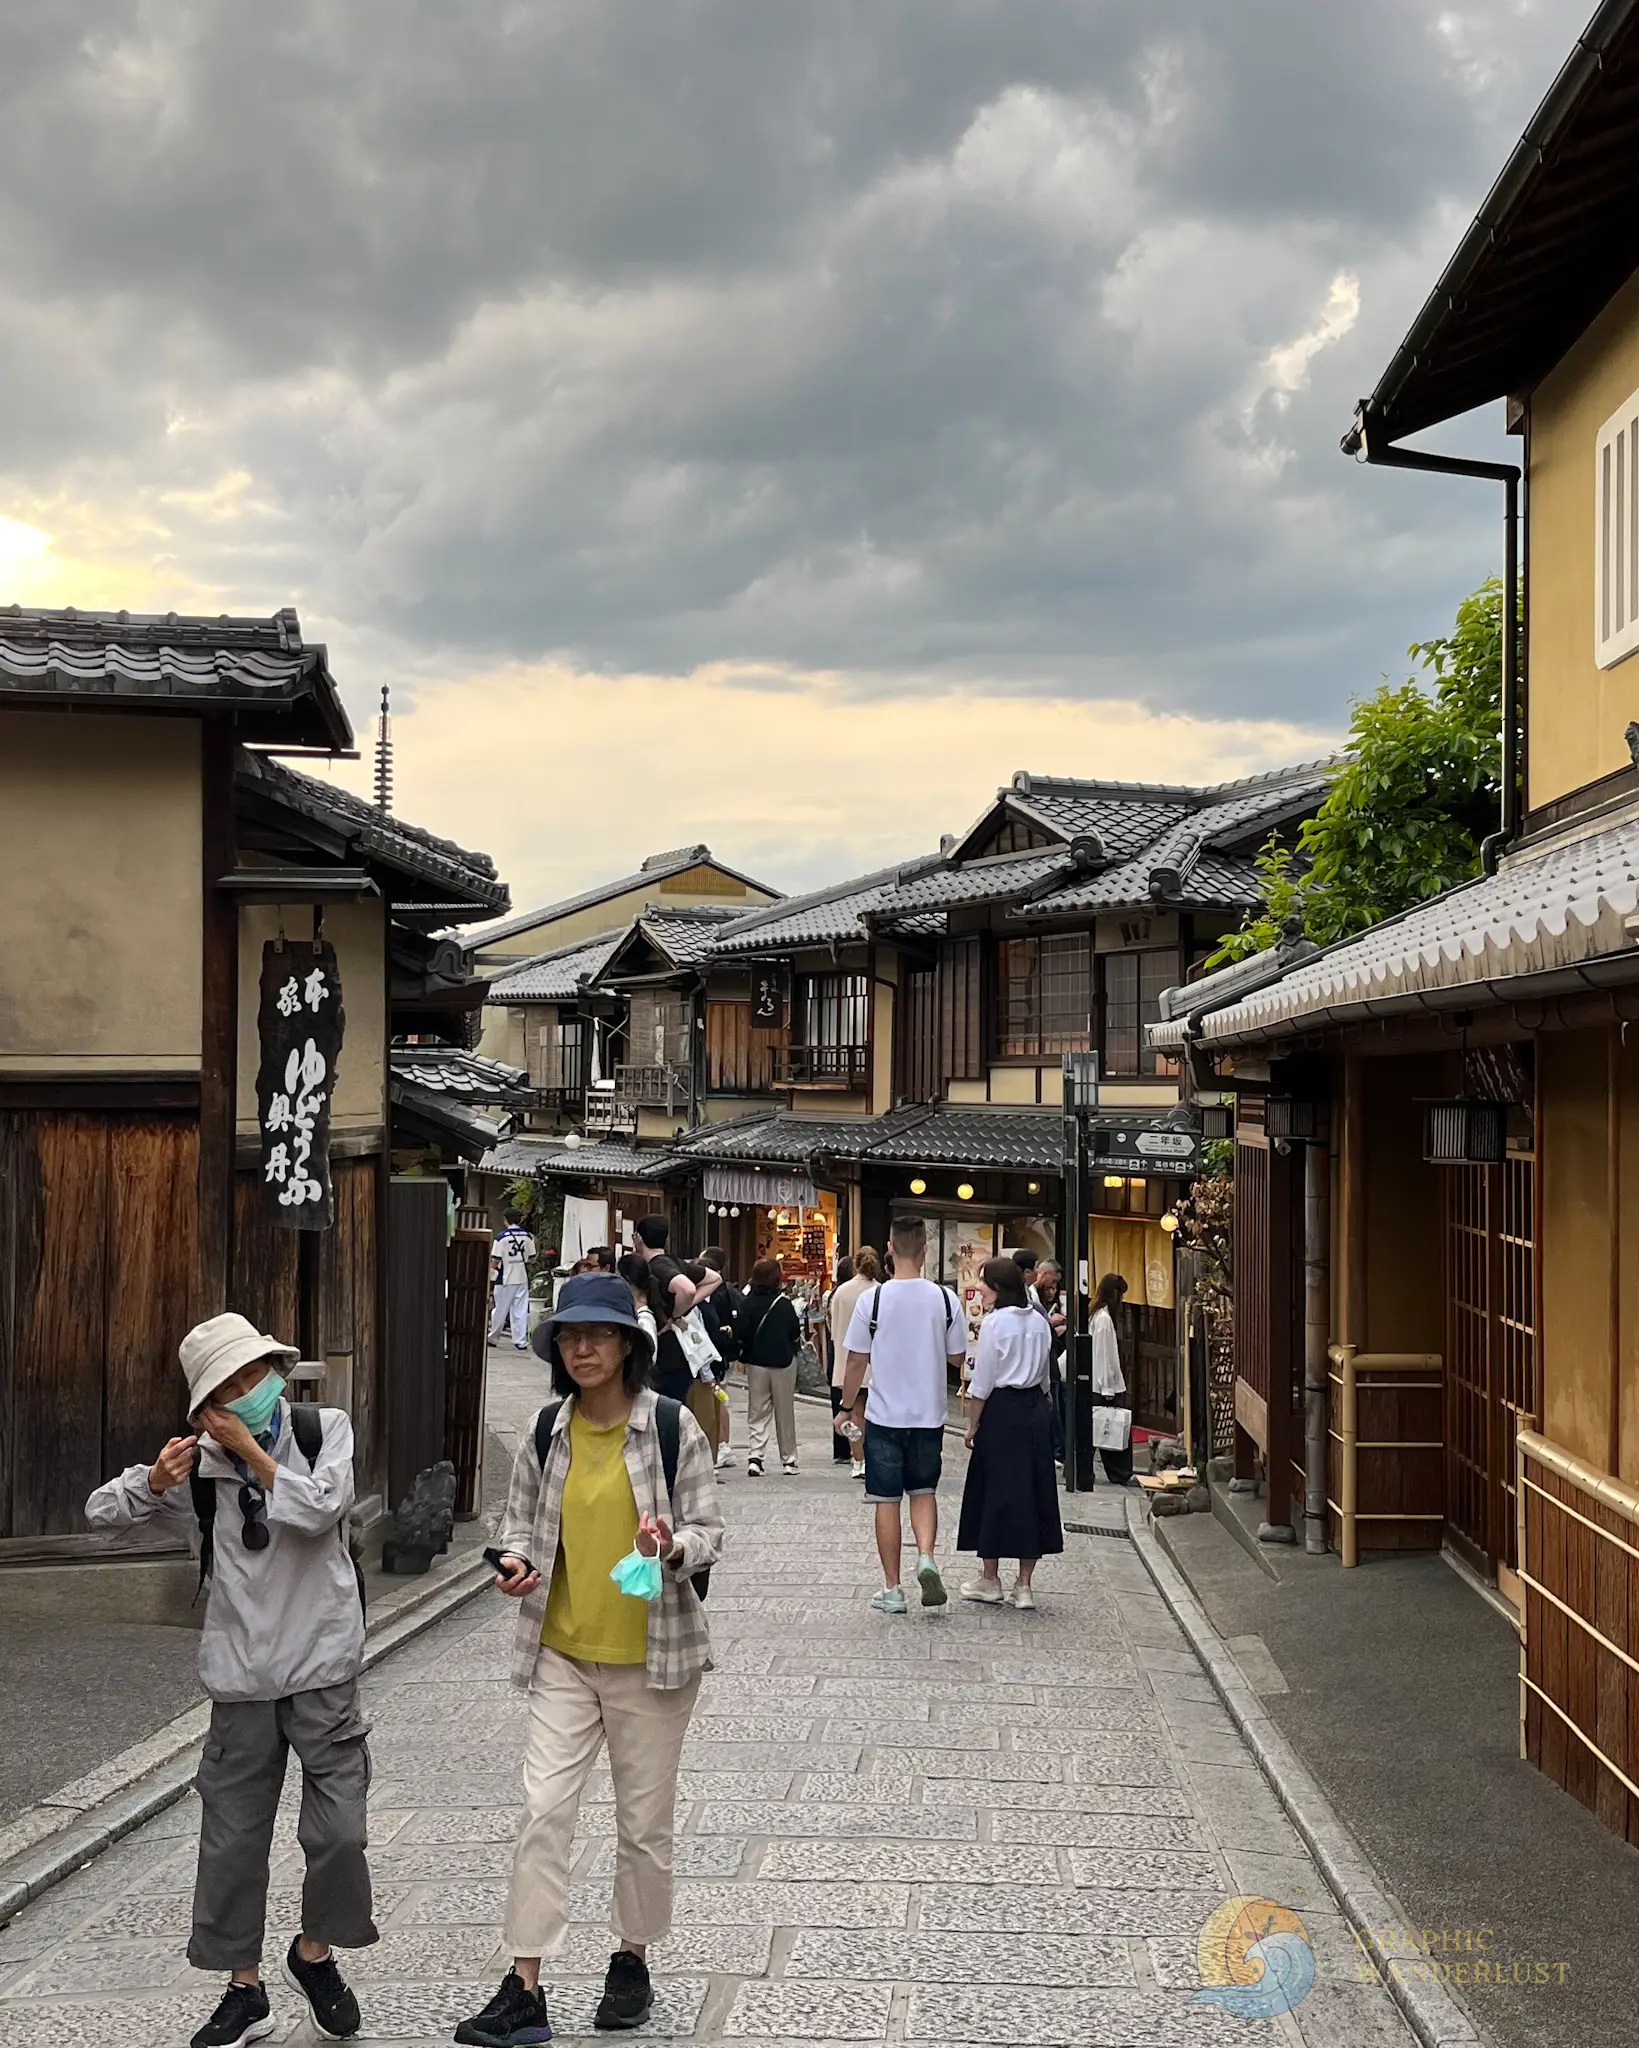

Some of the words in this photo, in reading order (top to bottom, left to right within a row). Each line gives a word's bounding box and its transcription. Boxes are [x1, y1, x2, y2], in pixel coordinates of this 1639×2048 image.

[265, 1092, 294, 1182] 奥丹
[279, 1038, 326, 1206] ゆどうふ
[1148, 1135, 1182, 1146] 二年坂
[508, 1240, 525, 1256] 34
